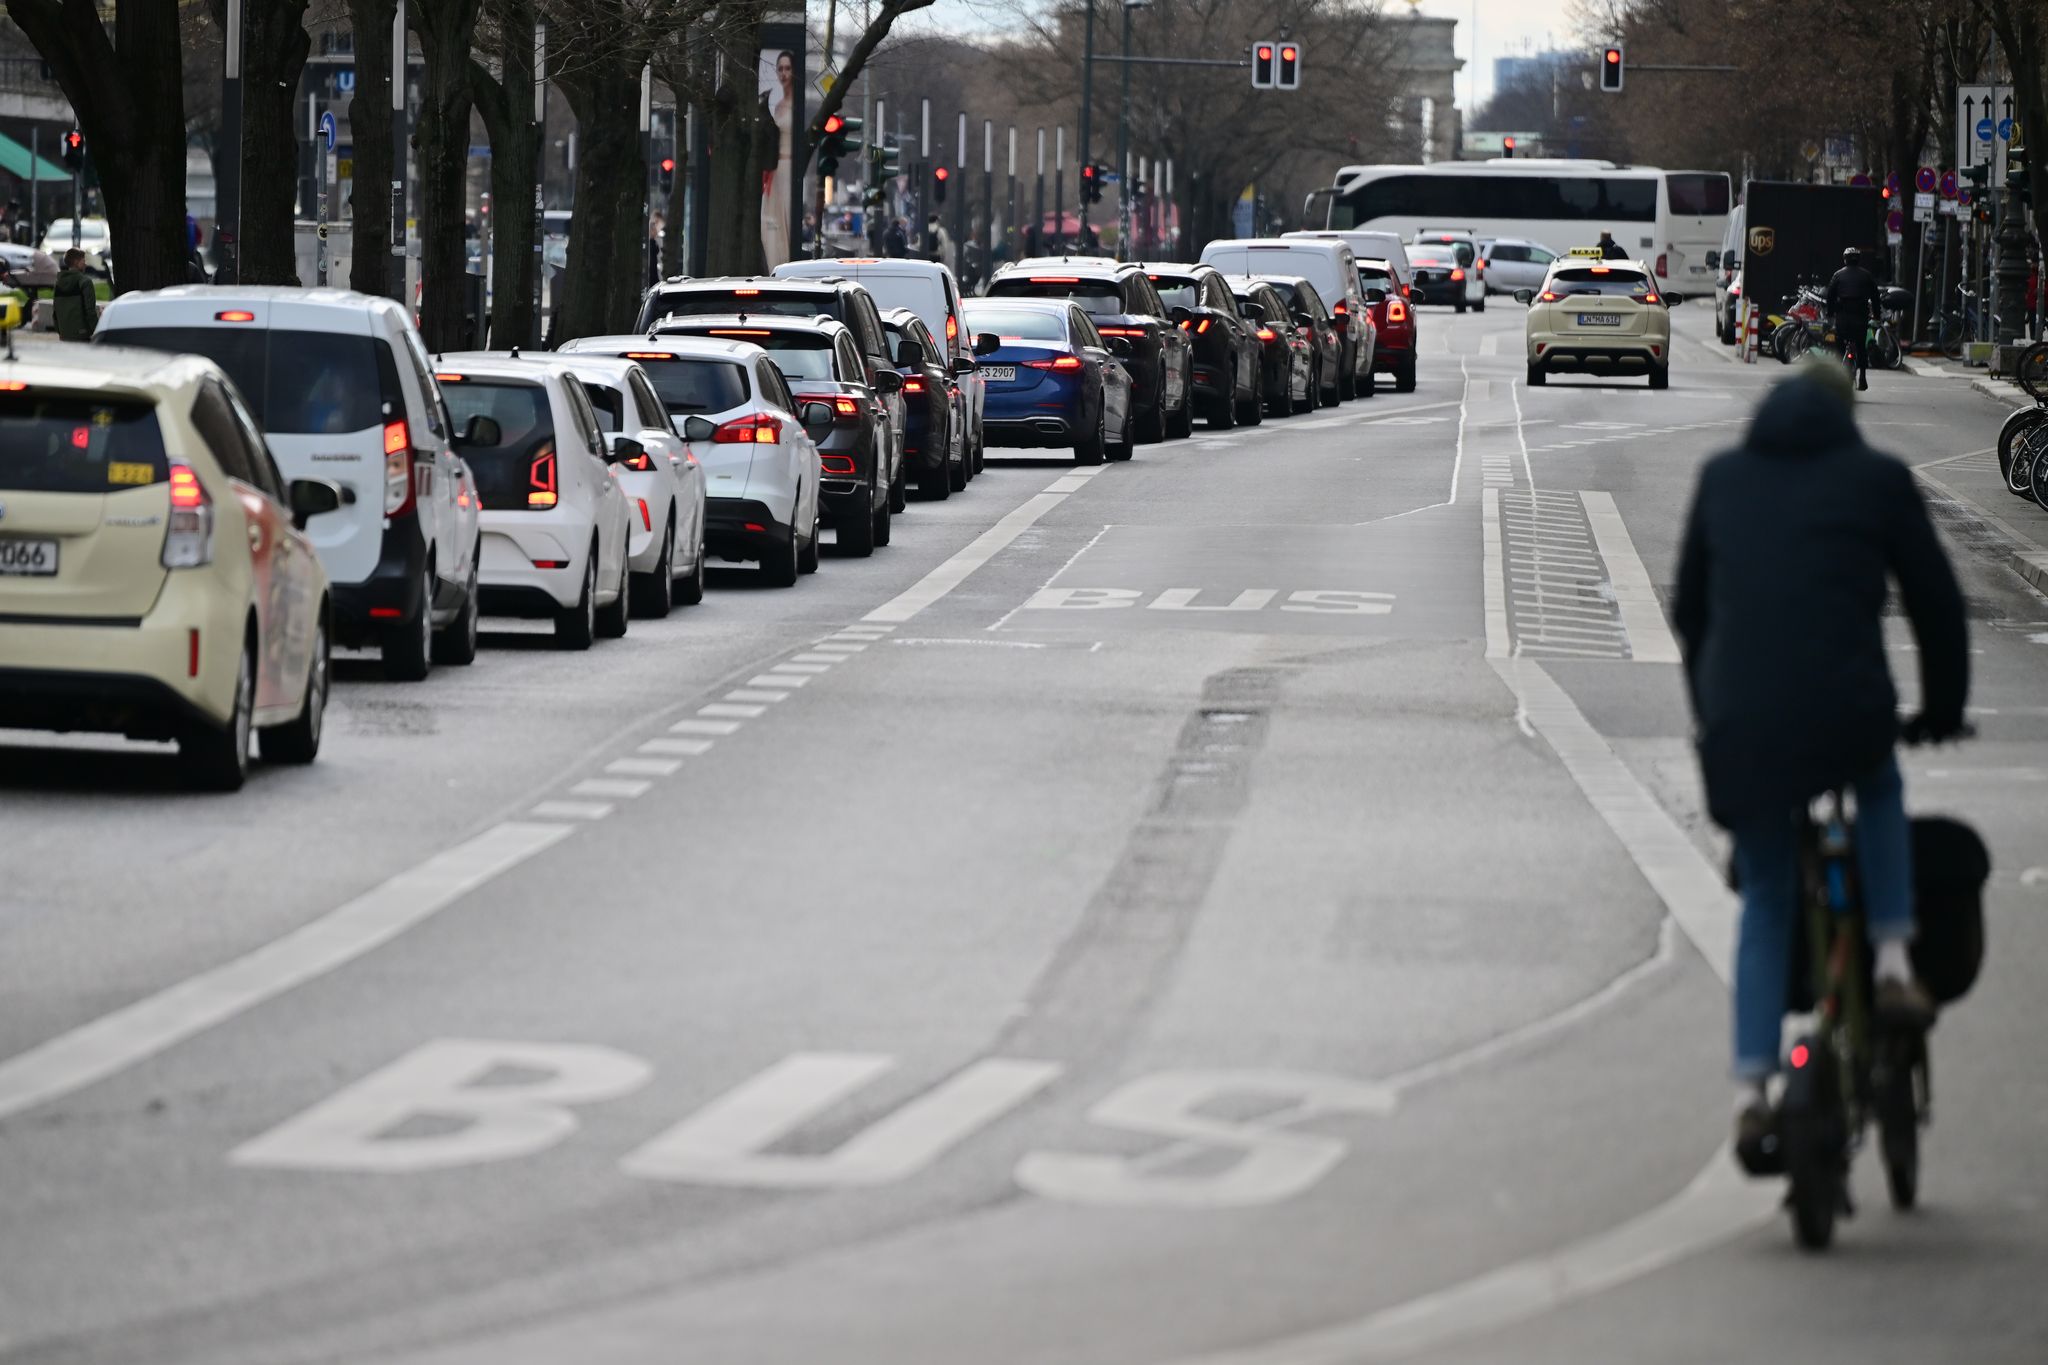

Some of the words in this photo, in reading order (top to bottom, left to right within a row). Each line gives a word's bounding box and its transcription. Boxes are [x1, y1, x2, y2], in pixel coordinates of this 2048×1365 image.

[340, 72, 354, 90] U
[1573, 248, 1599, 256] TAXI
[1751, 235, 1772, 251] ups
[992, 367, 1015, 378] 2907
[0, 543, 45, 565] 066
[1025, 588, 1397, 614] BUS
[227, 1038, 1397, 1205] BUS
